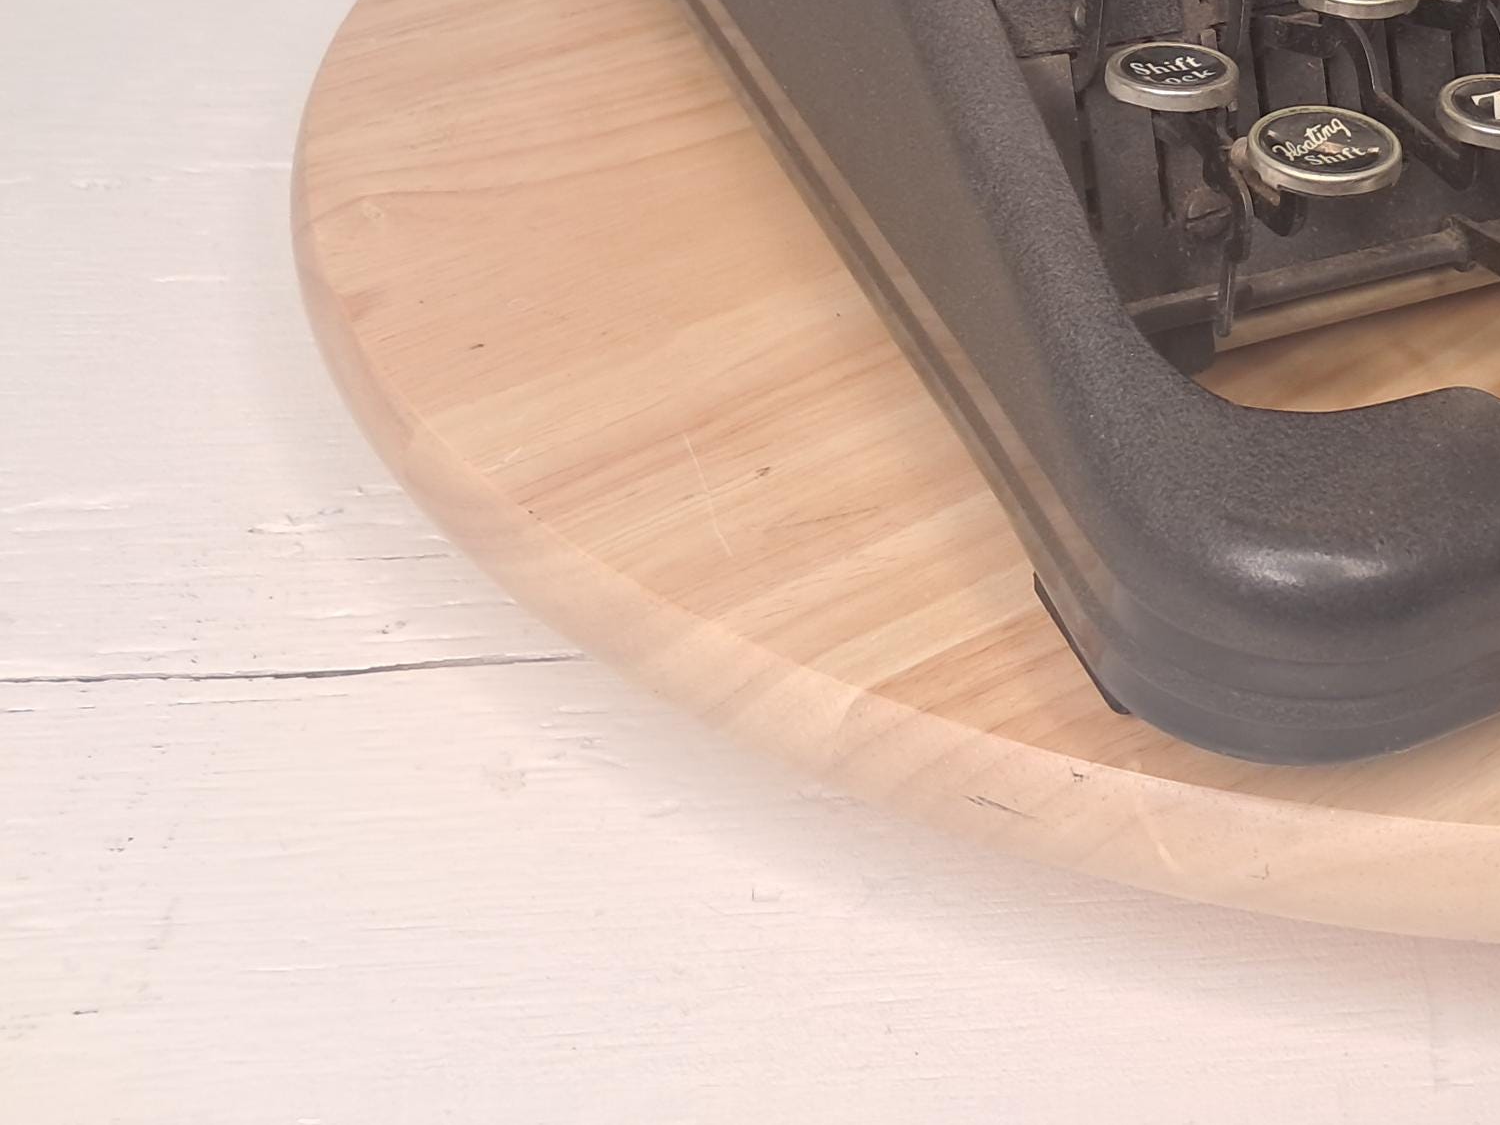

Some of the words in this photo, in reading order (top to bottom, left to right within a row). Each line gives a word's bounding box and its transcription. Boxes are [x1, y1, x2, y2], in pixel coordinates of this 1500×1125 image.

[1129, 56, 1203, 77] Shift
[1271, 118, 1352, 162] Floating
[1304, 146, 1367, 166] Shift
